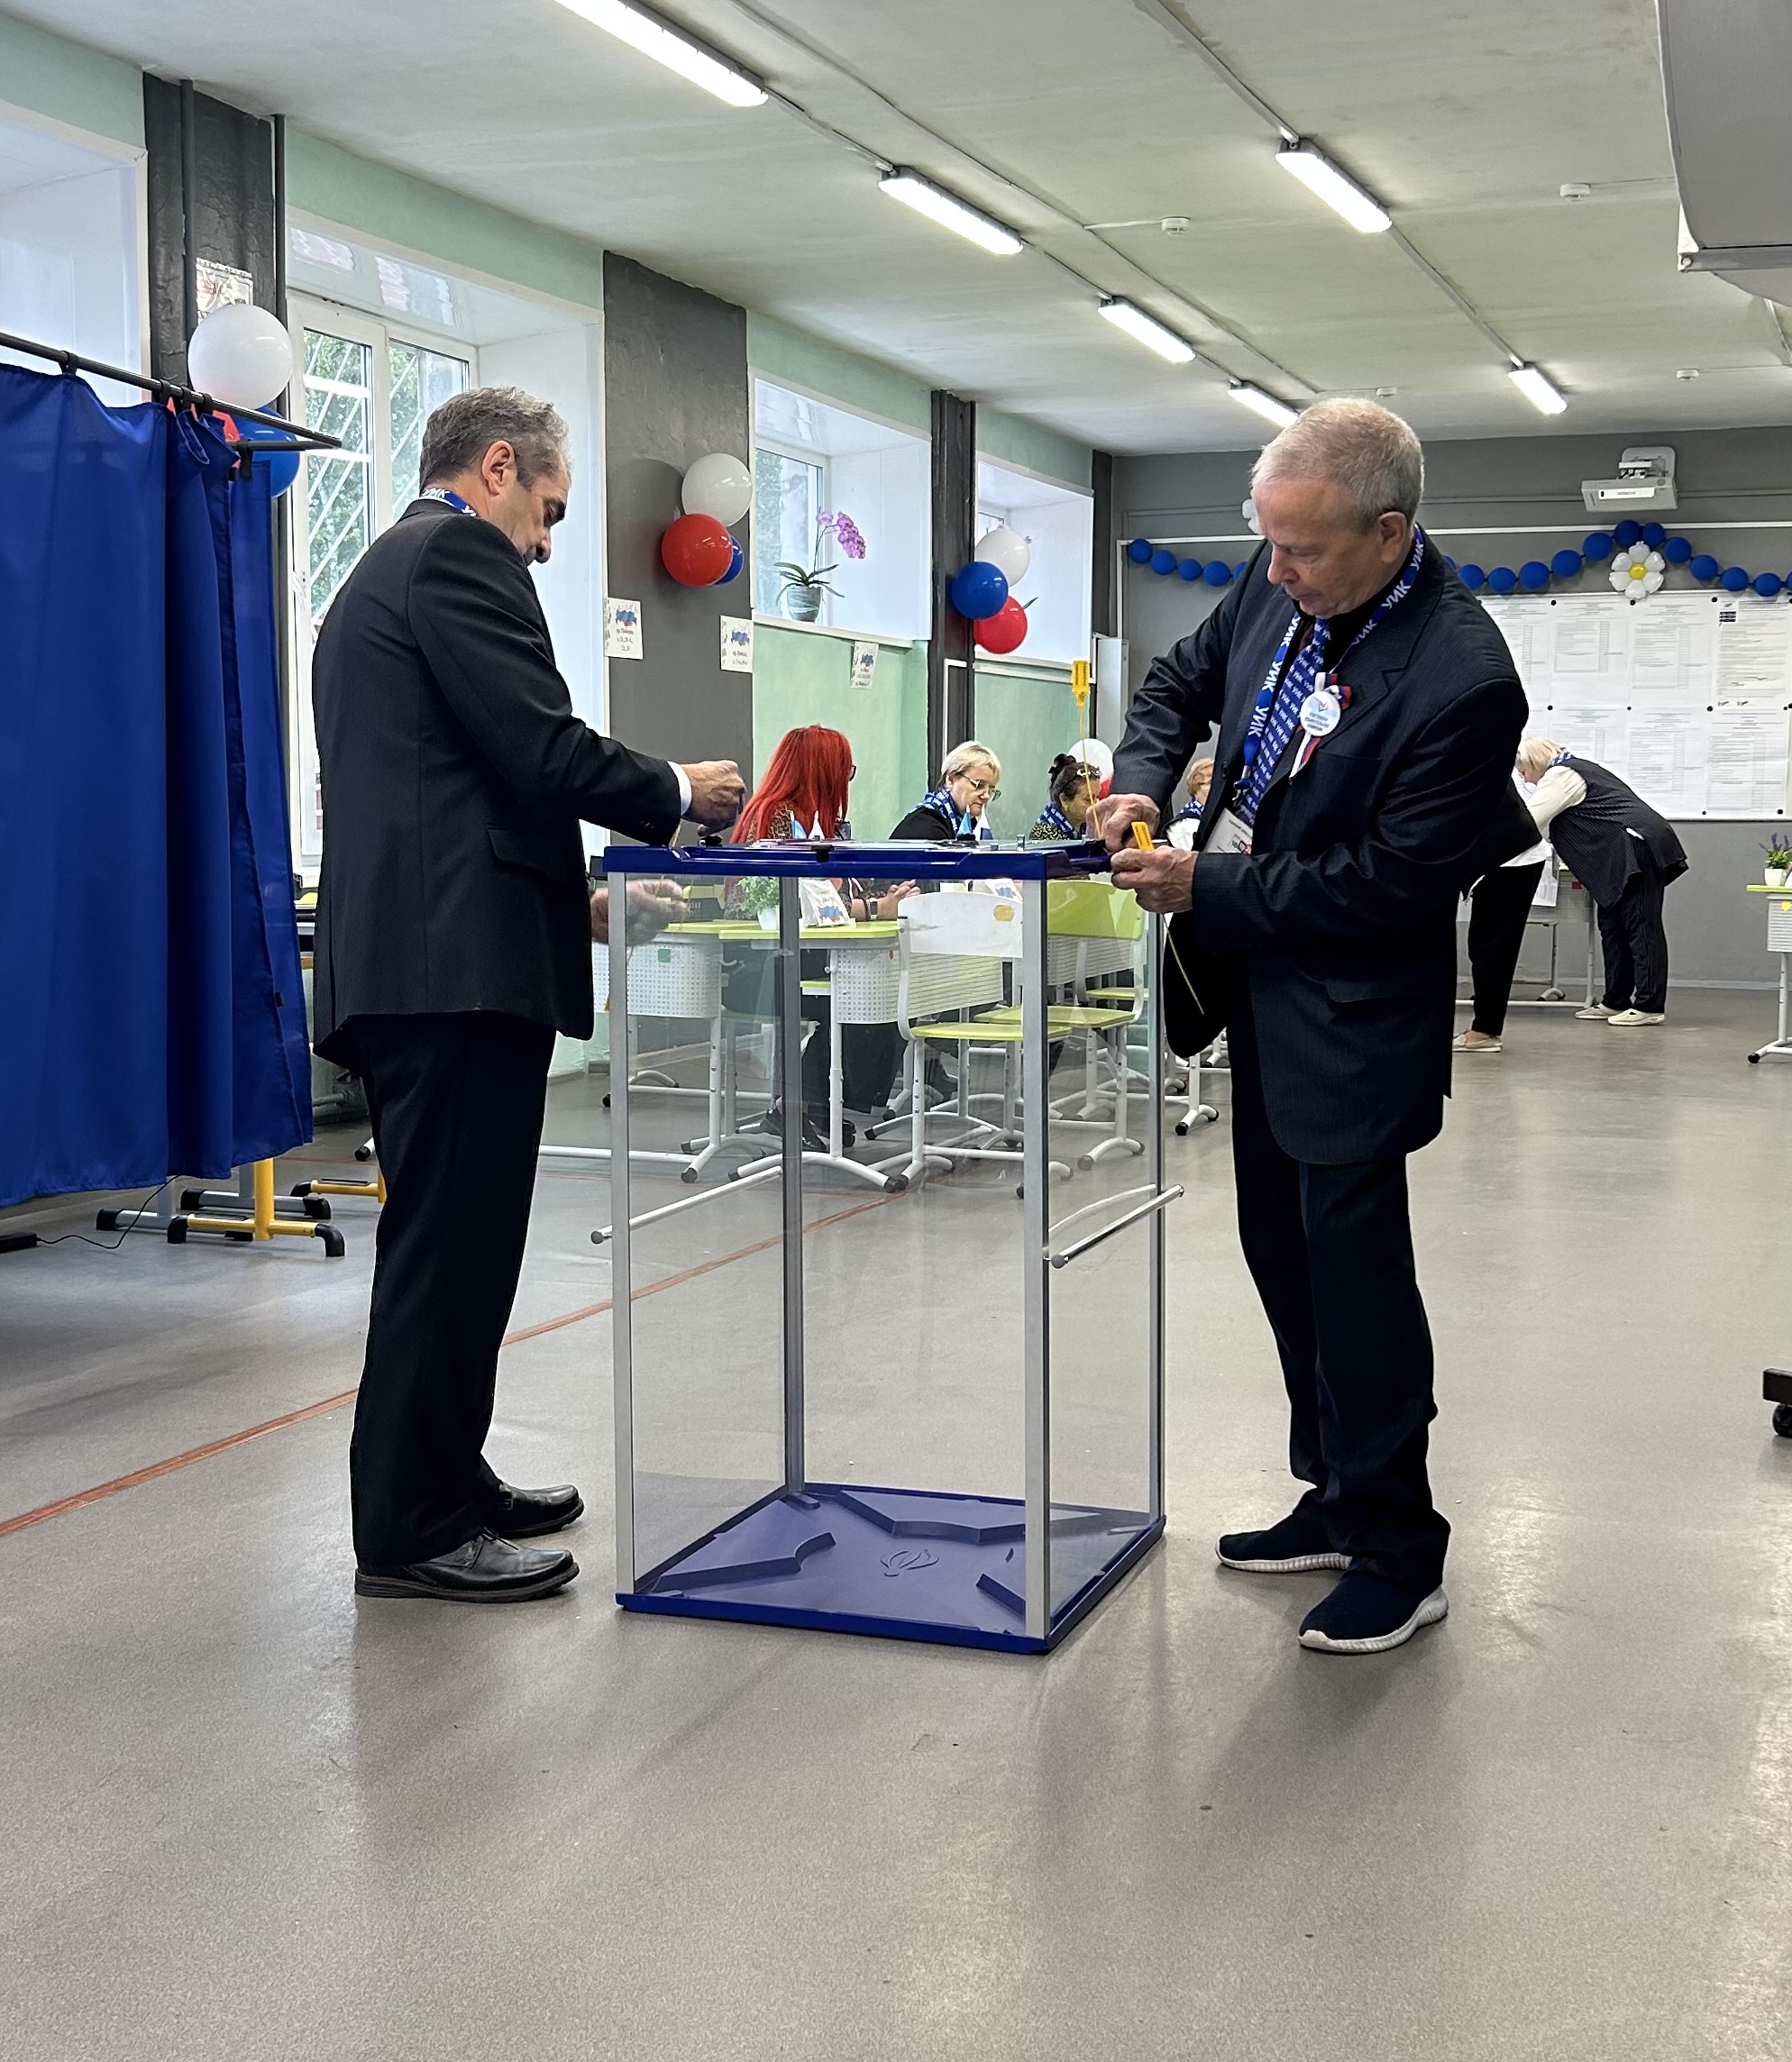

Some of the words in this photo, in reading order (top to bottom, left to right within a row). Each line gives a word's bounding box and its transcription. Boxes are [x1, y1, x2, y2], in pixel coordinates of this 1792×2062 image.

[1410, 539, 1424, 571] УИК
[1381, 579, 1412, 609] УИК
[1280, 616, 1302, 647] УИК
[1261, 660, 1284, 692] УИК
[1248, 705, 1269, 737] УИК
